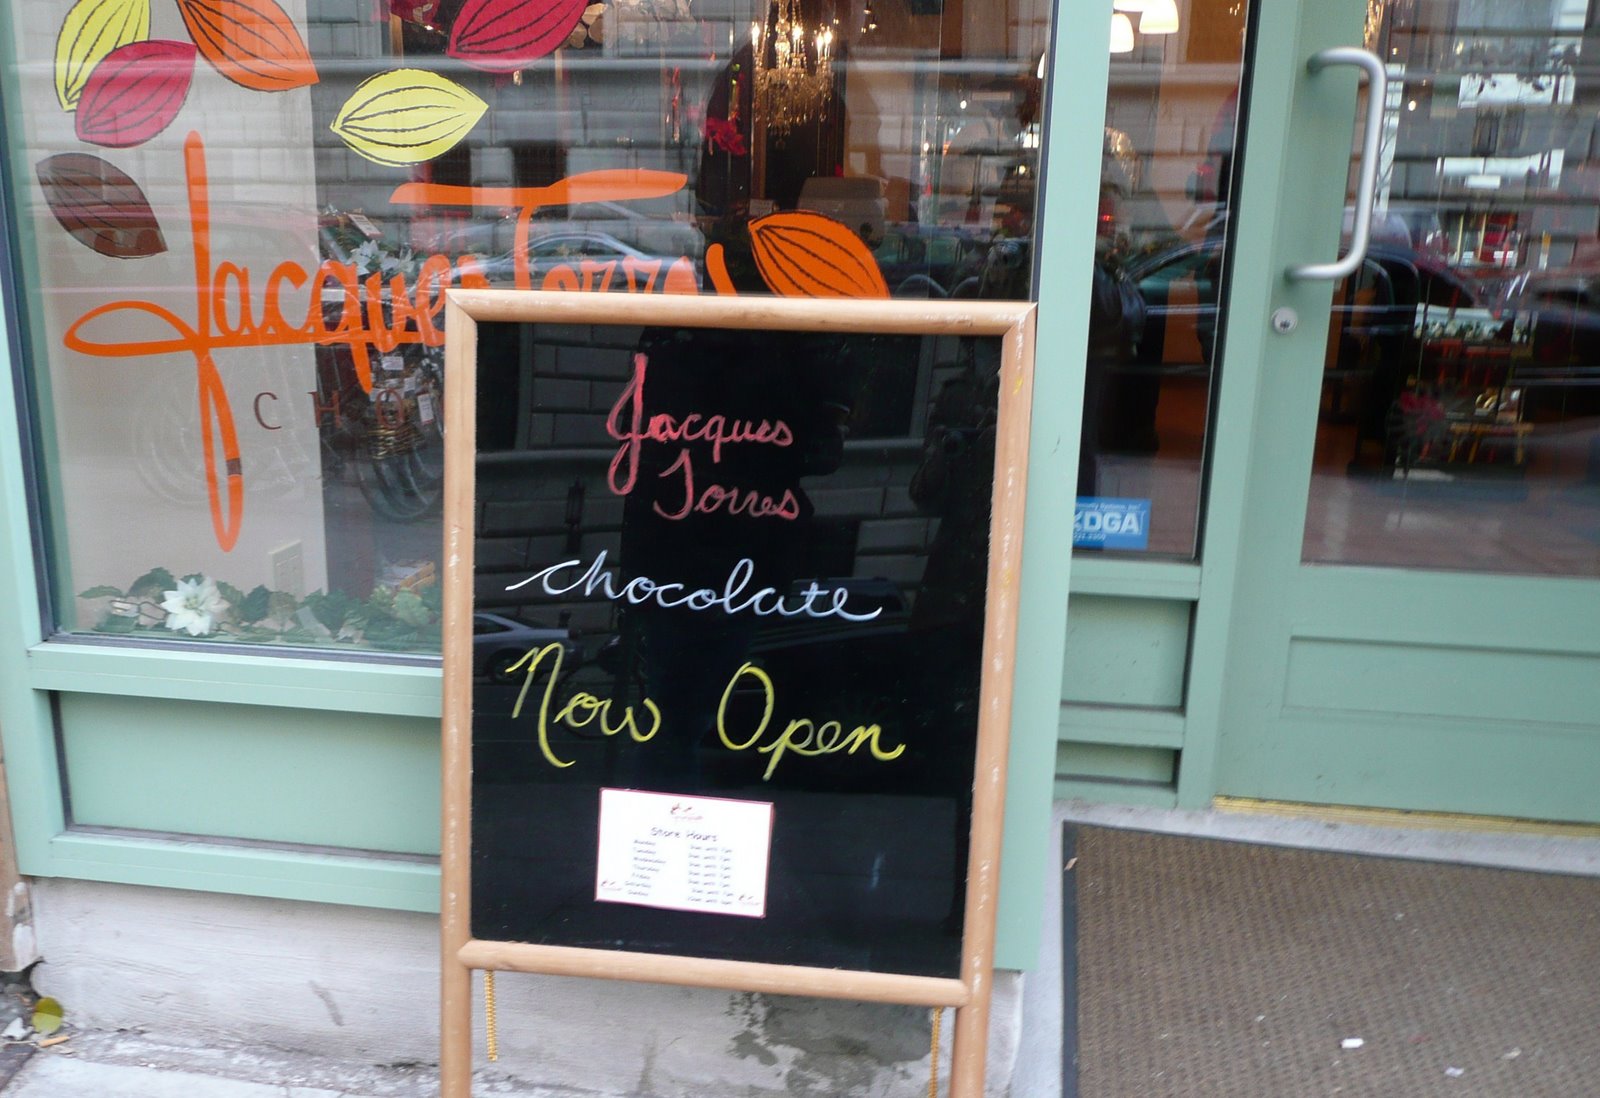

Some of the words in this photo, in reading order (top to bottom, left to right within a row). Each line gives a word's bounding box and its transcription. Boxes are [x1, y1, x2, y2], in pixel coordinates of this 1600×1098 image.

[605, 352, 794, 496] Jacques
[653, 448, 800, 520] Torres
[505, 641, 662, 769] Now
[716, 661, 906, 782] Open
